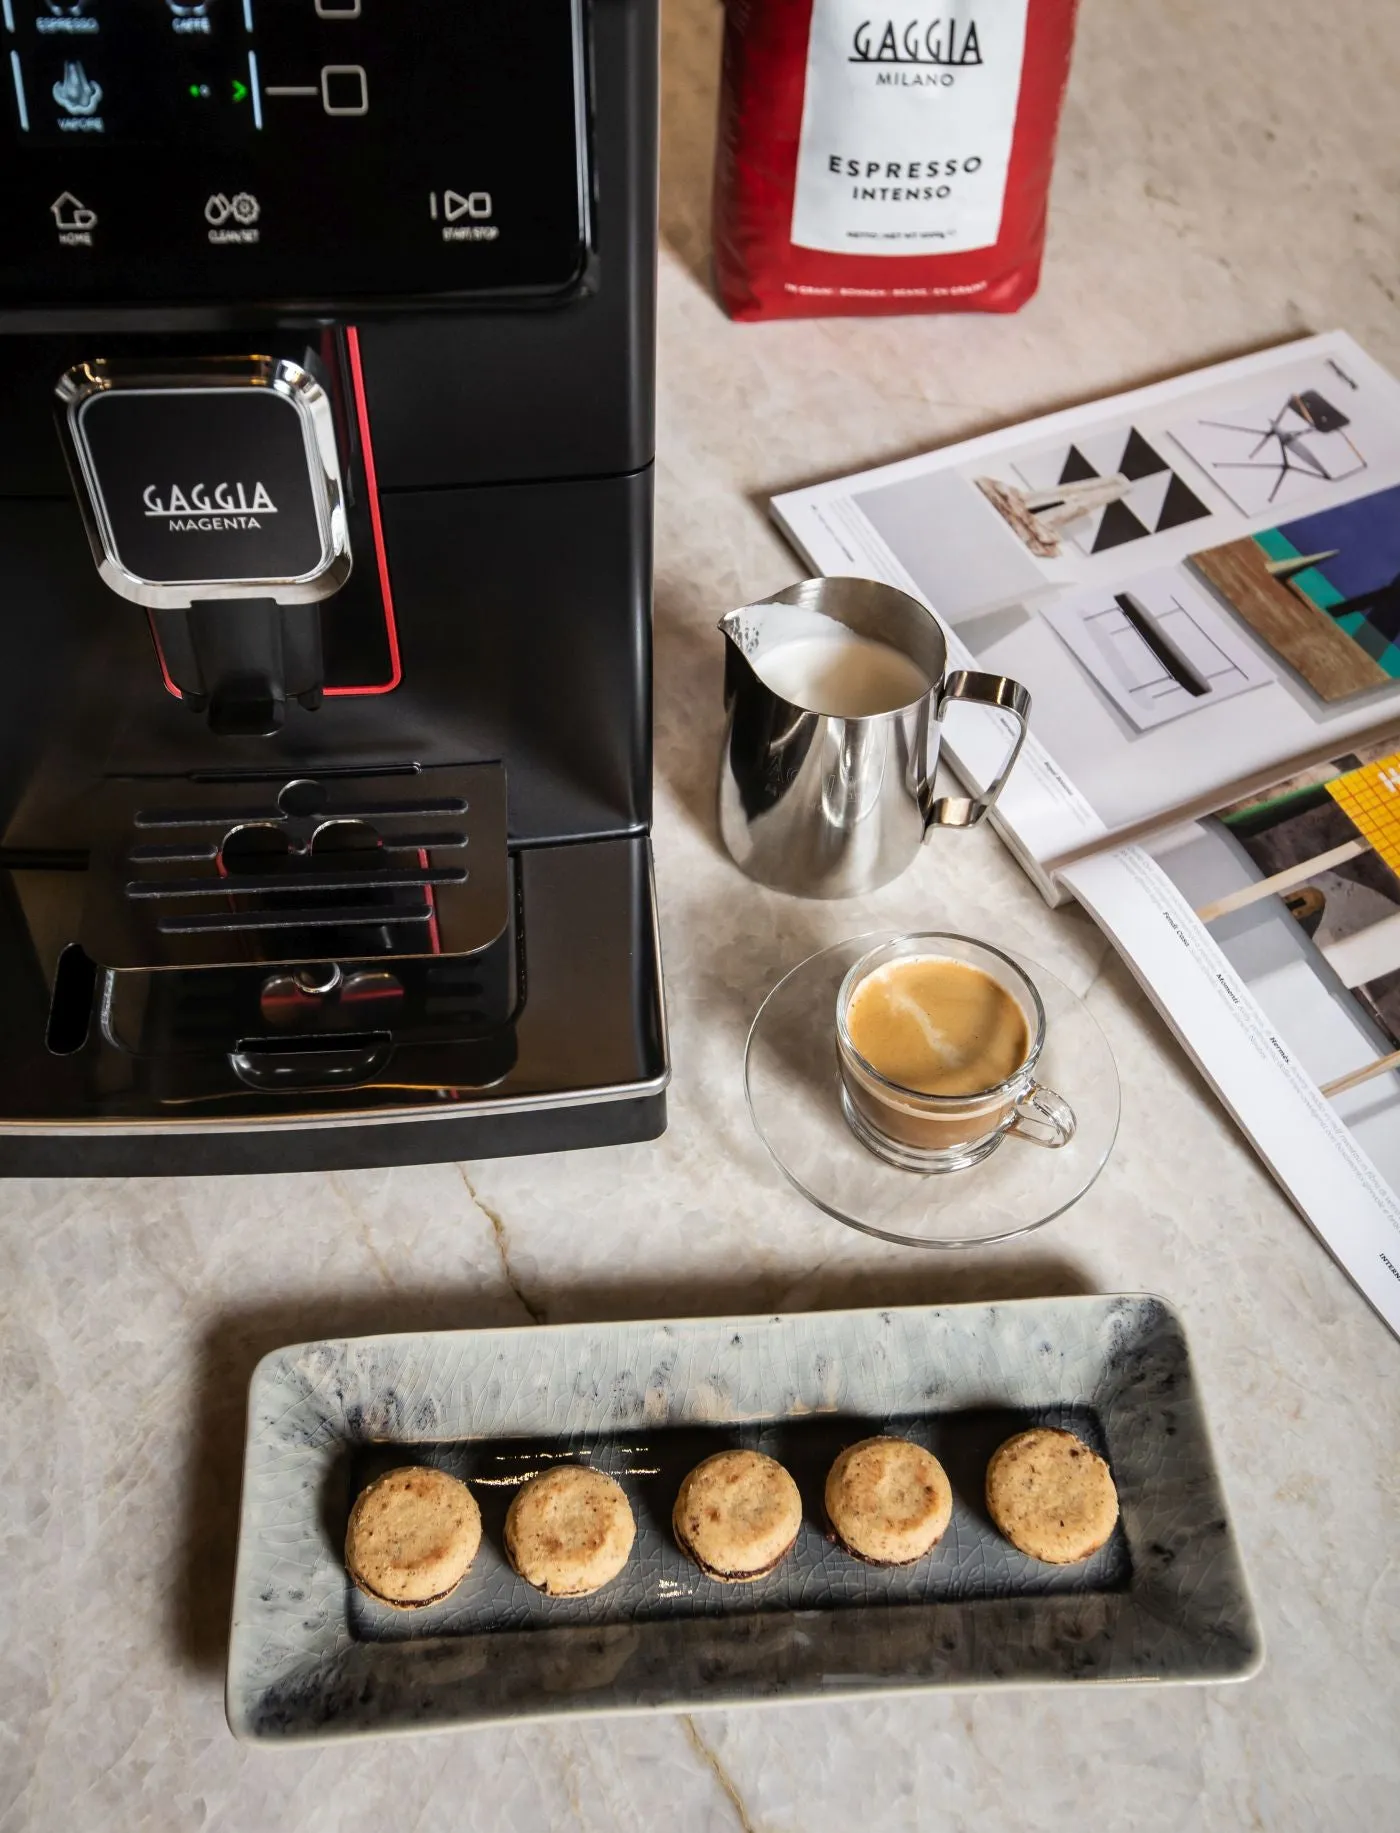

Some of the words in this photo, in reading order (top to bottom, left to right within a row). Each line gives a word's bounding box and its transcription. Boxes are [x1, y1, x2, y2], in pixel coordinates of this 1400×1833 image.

[848, 18, 983, 65] GAGGIA
[876, 72, 955, 87] MILANO
[829, 154, 982, 179] ESPRESSO
[853, 184, 951, 201] INTENSO
[58, 232, 93, 246] HOME
[143, 482, 278, 515] GAGGIA
[169, 516, 261, 531] MAGENTA
[1163, 911, 1178, 930] Fendi
[1379, 1252, 1400, 1282] INTERN
